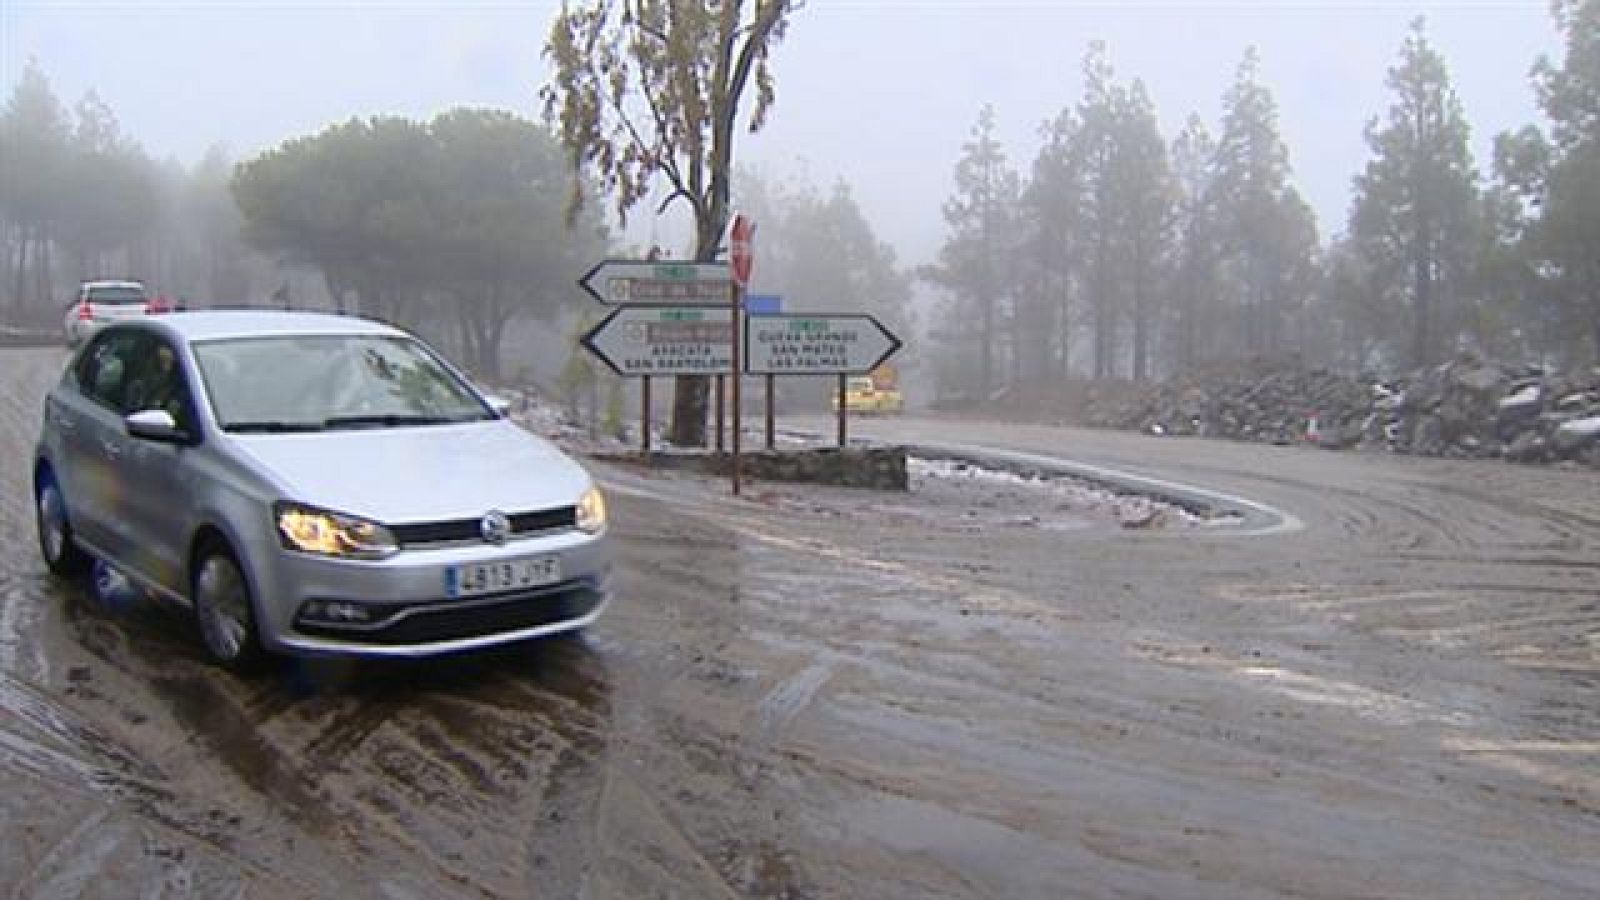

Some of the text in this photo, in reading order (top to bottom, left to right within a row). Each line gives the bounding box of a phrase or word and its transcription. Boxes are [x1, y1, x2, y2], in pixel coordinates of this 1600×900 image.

[772, 343, 846, 355] SAN MATEO
[625, 359, 653, 369] SAN
[768, 356, 848, 368] LAS PALMAS
